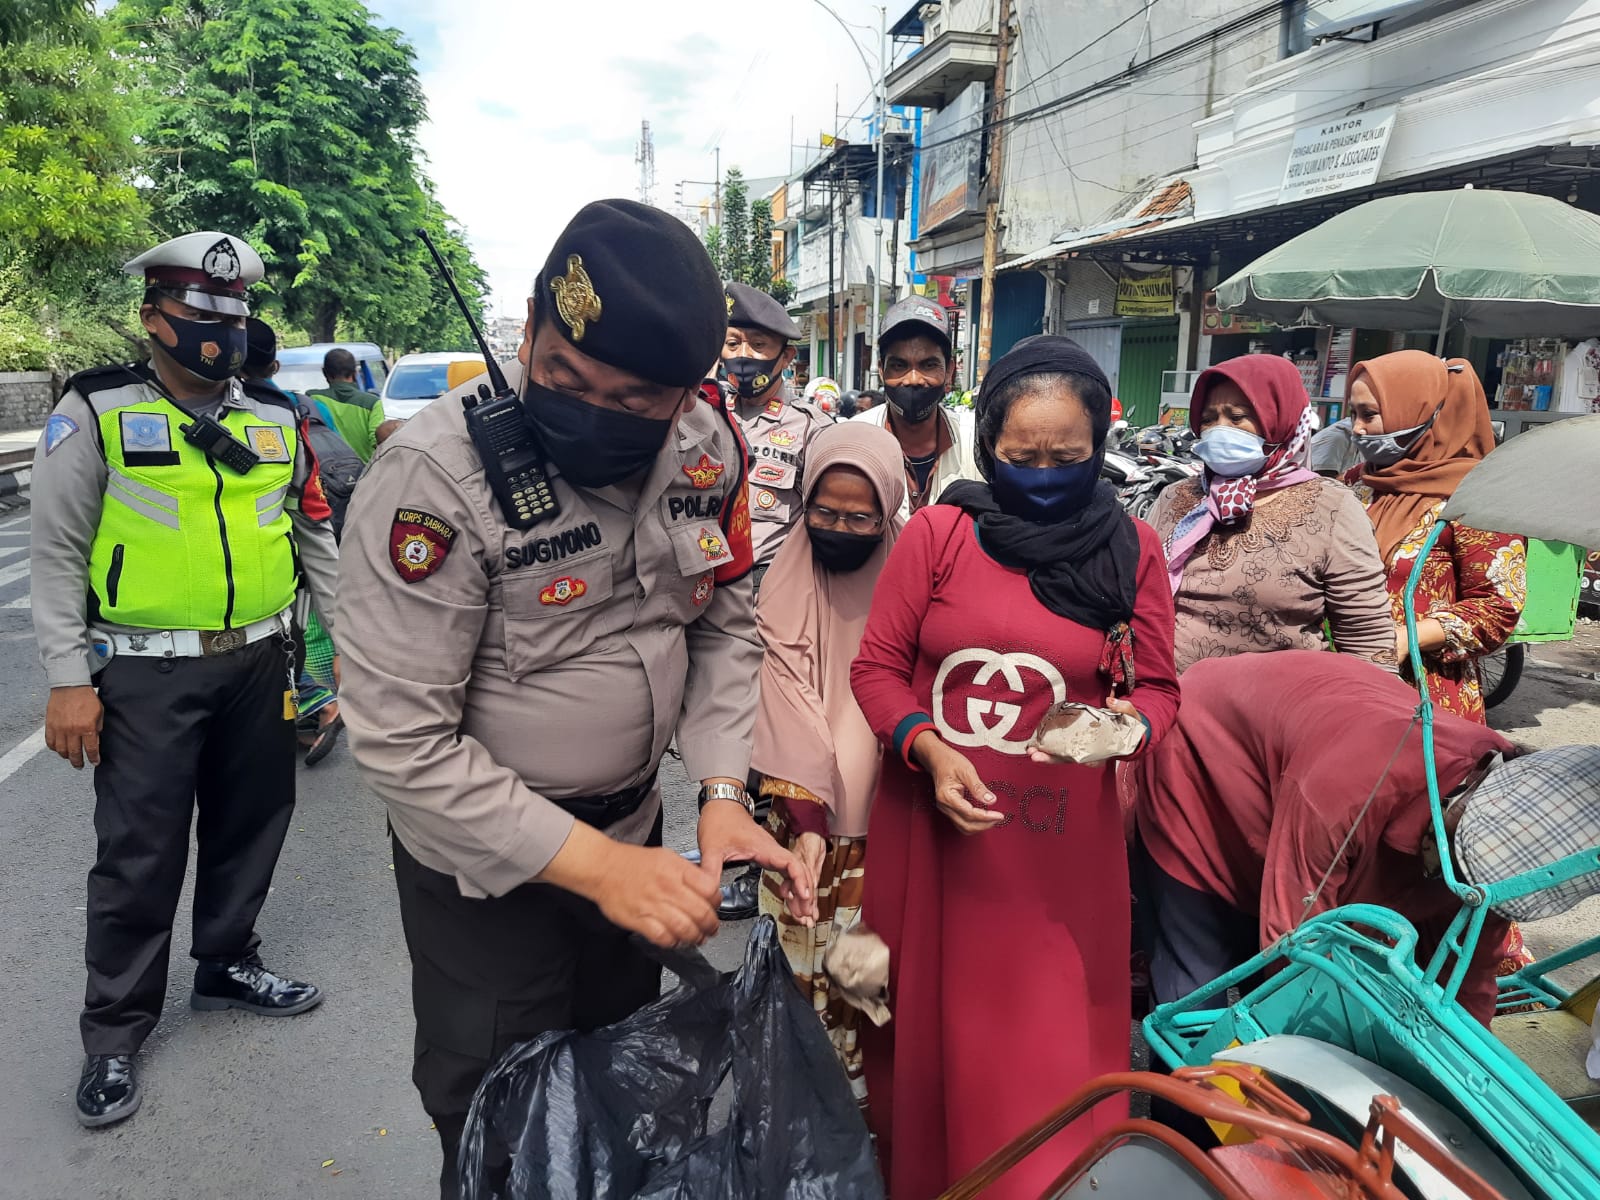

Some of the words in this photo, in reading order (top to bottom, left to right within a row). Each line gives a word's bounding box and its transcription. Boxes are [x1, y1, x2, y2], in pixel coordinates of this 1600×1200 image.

[1320, 119, 1362, 136] KANTOR
[1340, 145, 1380, 167] ASSOCIATES
[200, 356, 214, 366] TNI
[753, 446, 794, 464] POLRI
[399, 511, 423, 524] KORPS
[423, 516, 454, 540] SABHARA
[506, 522, 601, 568] SUGIYONO
